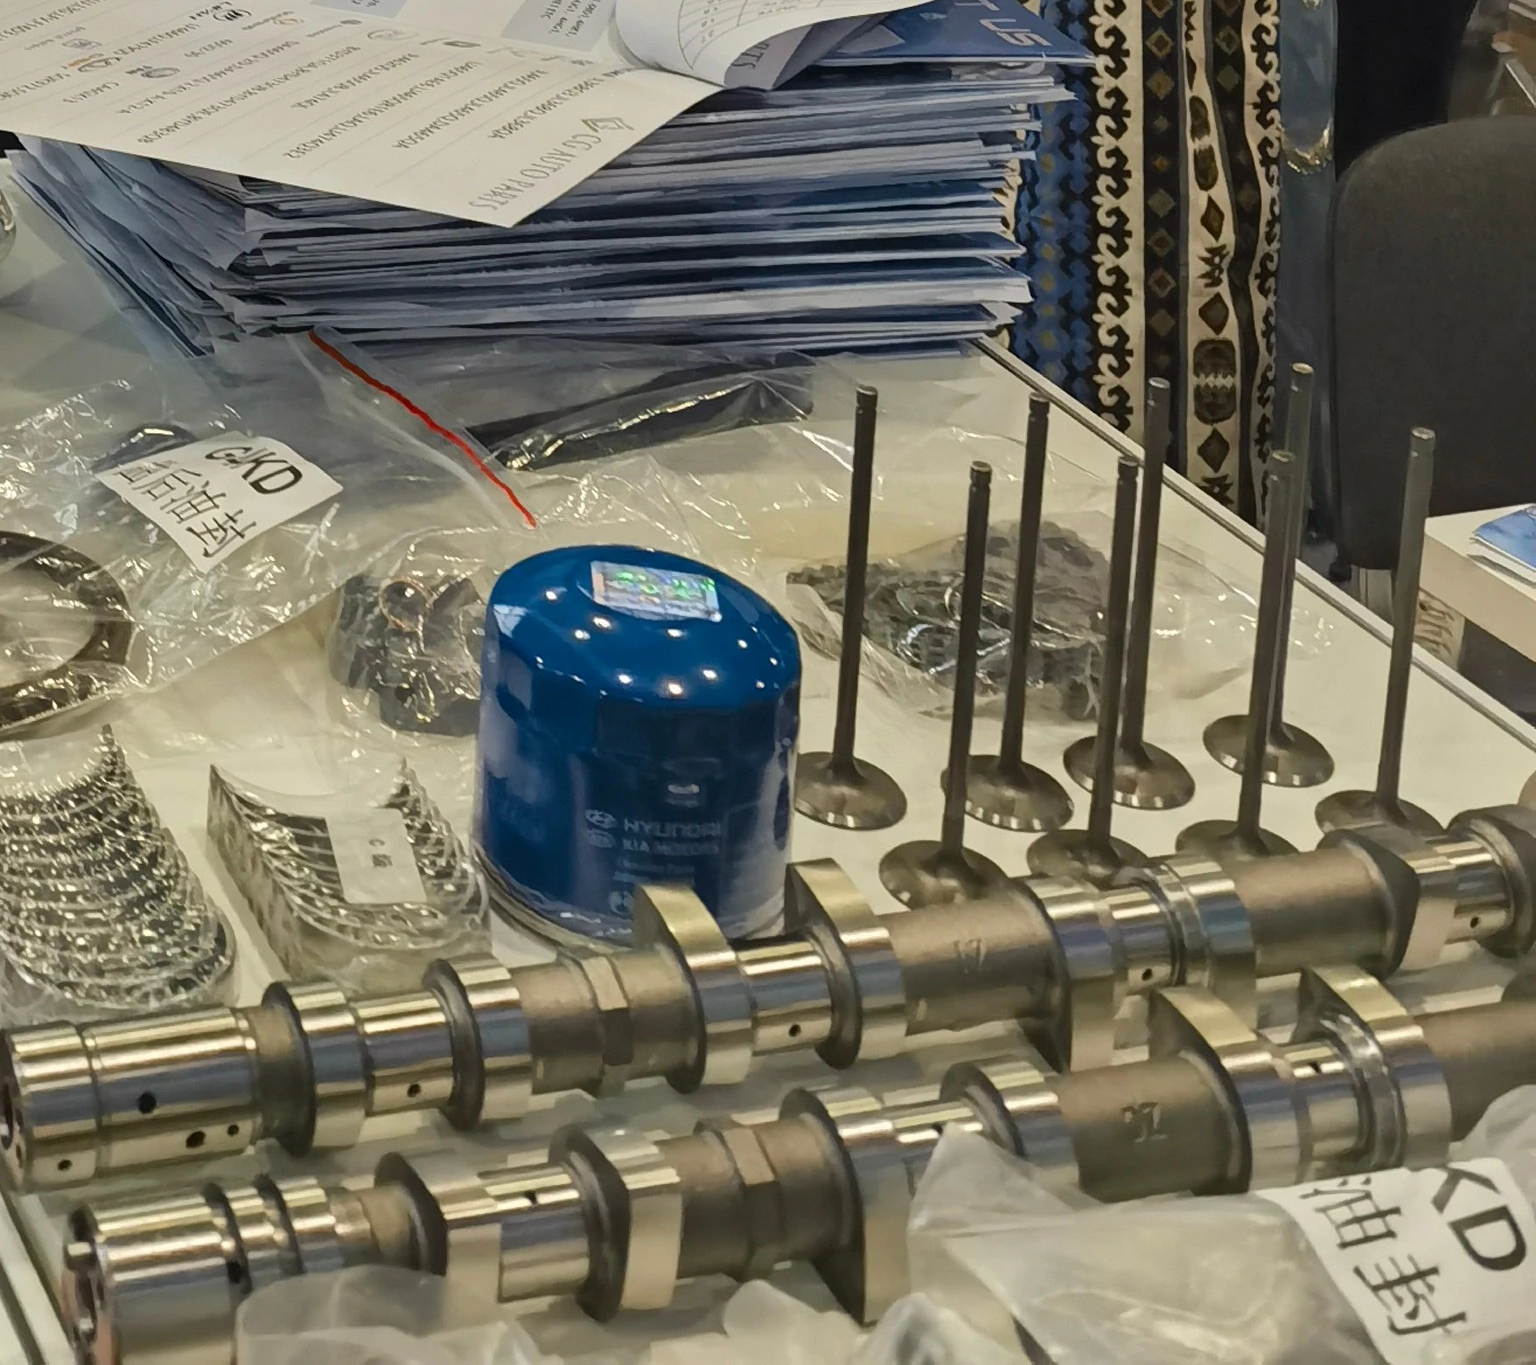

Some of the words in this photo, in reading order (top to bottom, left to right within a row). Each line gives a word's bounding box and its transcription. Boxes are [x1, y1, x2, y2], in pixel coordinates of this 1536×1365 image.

[520, 147, 575, 180] AUTO
[468, 177, 536, 211] PARTS
[1299, 1176, 1467, 1336] 油封
